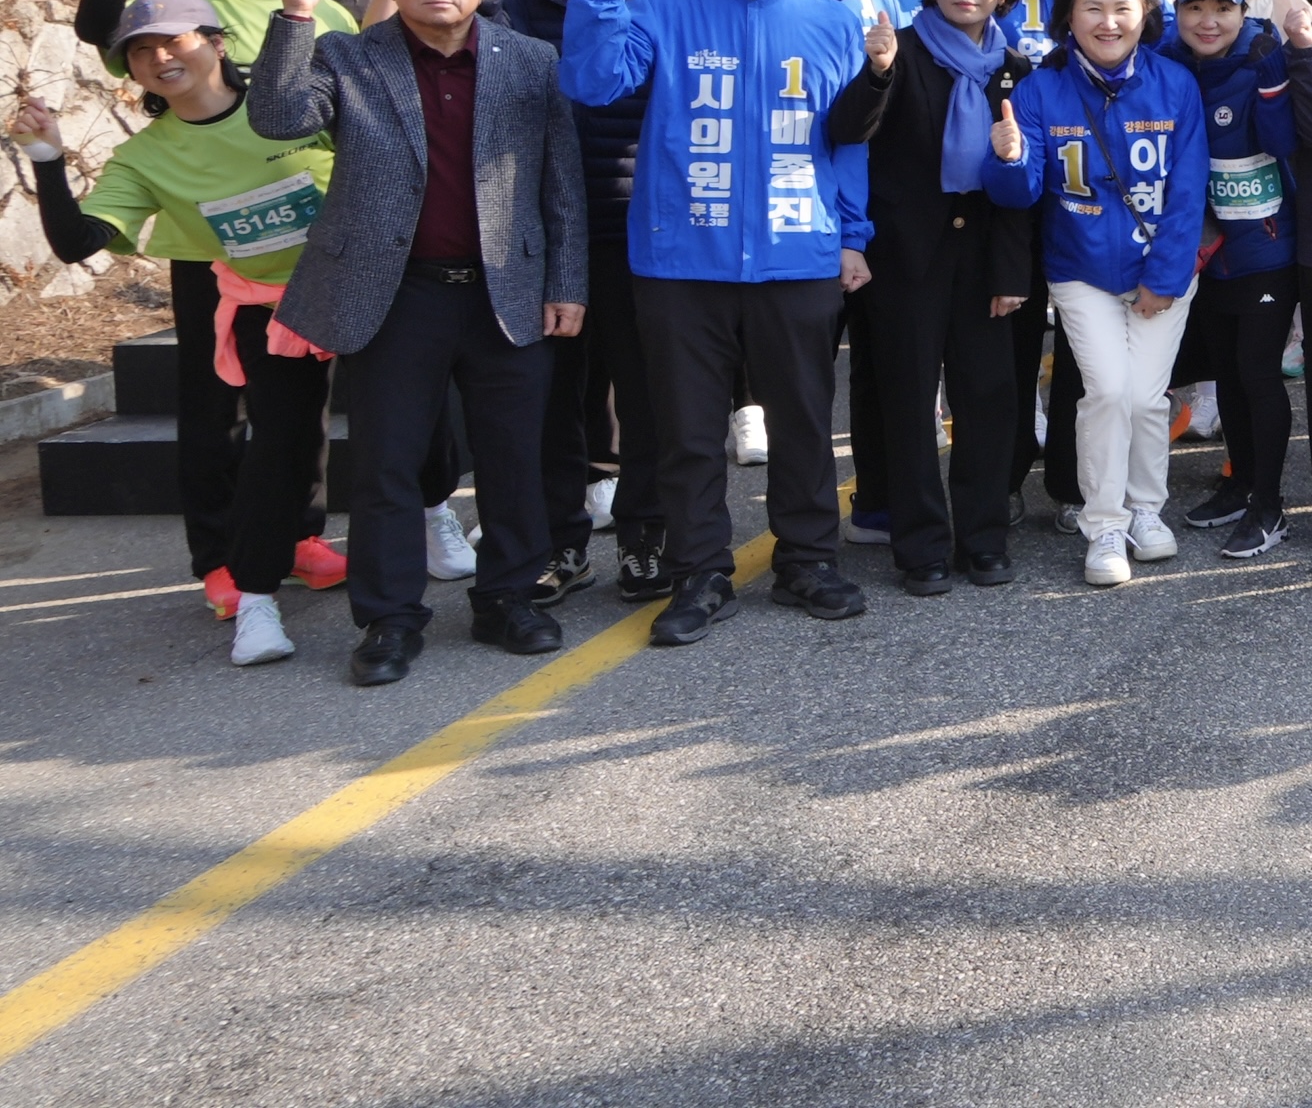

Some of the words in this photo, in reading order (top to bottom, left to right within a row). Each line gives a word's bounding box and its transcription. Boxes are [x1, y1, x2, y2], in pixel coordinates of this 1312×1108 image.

[687, 55, 740, 70] 민주당
[779, 57, 807, 98] 1
[687, 74, 735, 198] 시의원
[767, 109, 815, 233] 배종진
[1057, 140, 1092, 197] 1
[1208, 179, 1262, 197] 15066
[219, 204, 297, 238] 15145
